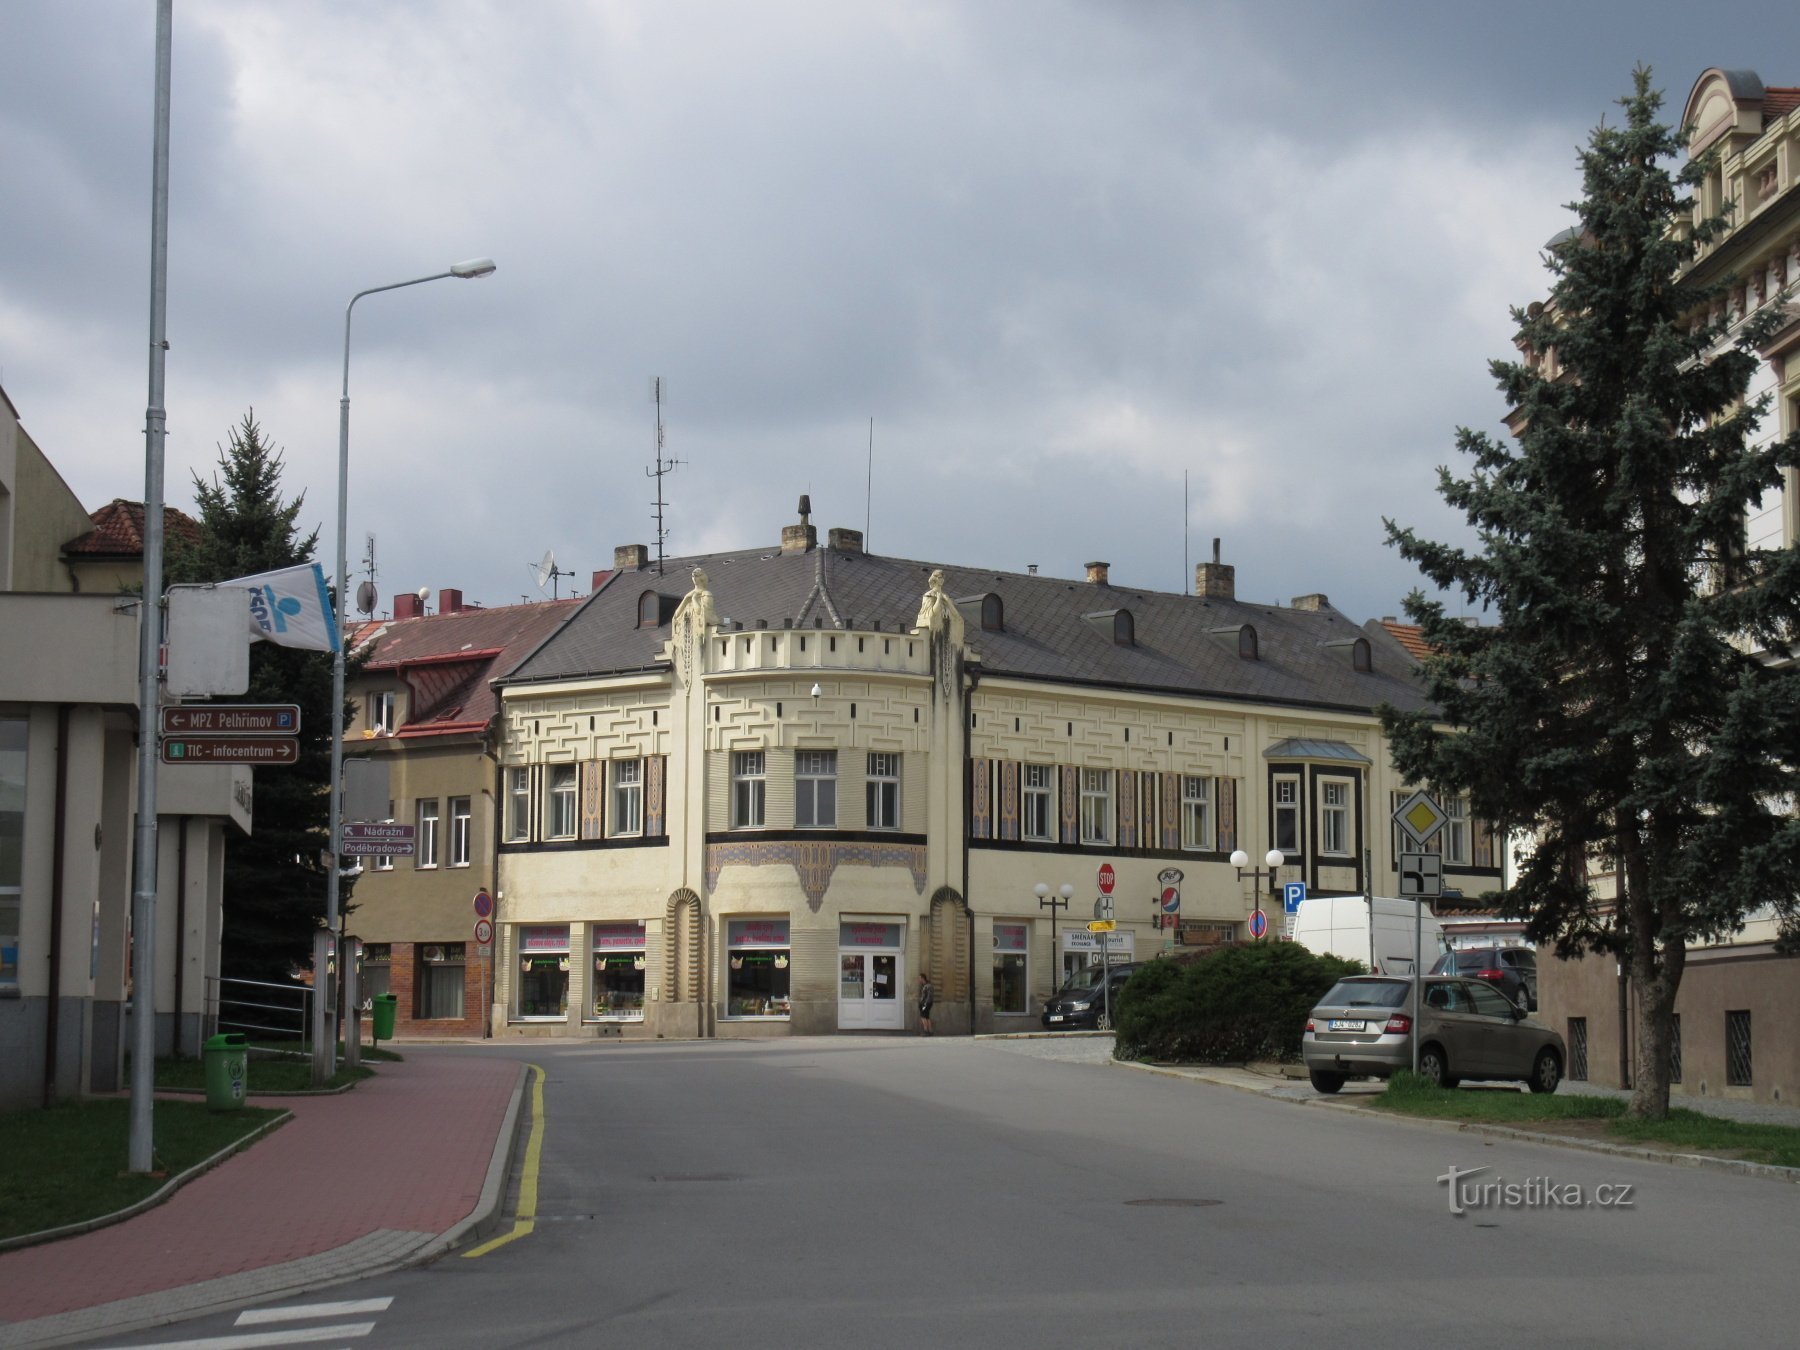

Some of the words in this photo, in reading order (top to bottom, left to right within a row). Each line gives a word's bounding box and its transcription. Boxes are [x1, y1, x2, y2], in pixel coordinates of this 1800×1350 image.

[190, 713, 212, 728] MPZ
[219, 712, 272, 728] Pelhřimov
[187, 745, 203, 757] TIC
[213, 745, 274, 757] infocentrum
[364, 826, 404, 836] Nádražní
[344, 843, 403, 853] Poděbradova
[1100, 872, 1114, 885] STOP
[1289, 886, 1300, 904] P
